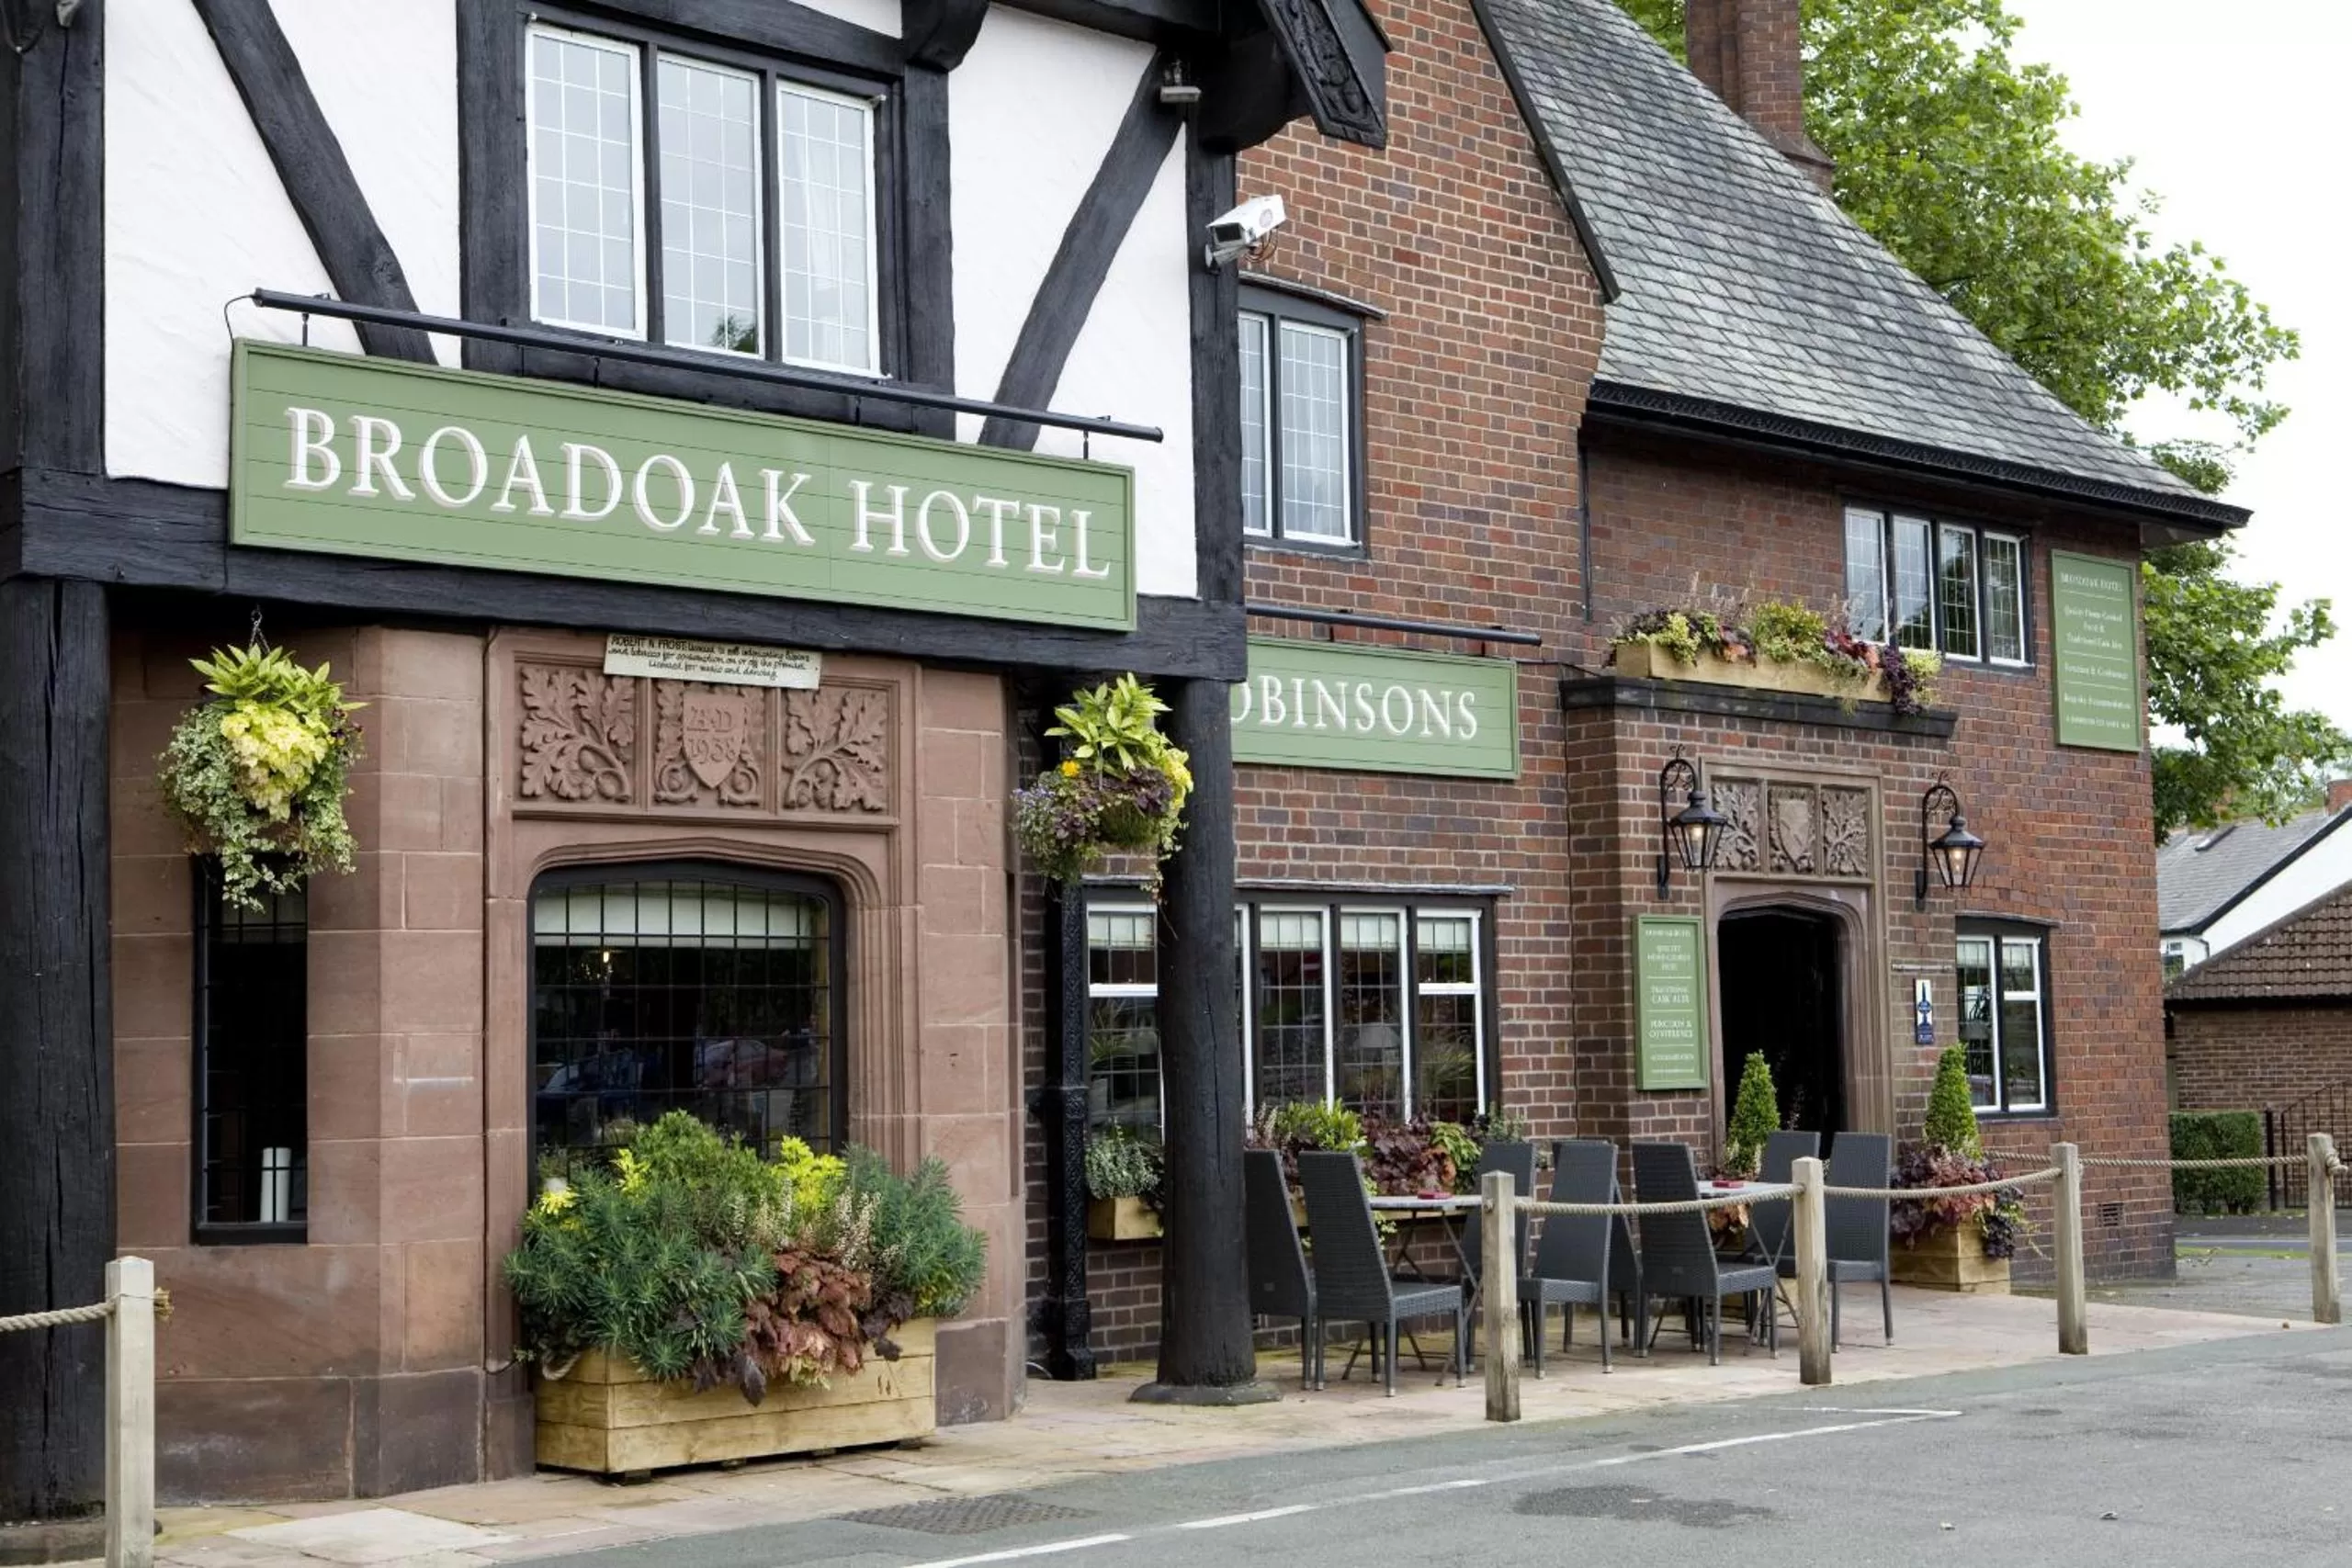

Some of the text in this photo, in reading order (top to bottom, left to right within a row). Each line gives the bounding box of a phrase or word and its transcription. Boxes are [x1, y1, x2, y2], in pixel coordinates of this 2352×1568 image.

[284, 405, 1111, 580] BROADOAK HOTEL
[1230, 675, 1477, 739] OBINSONS
